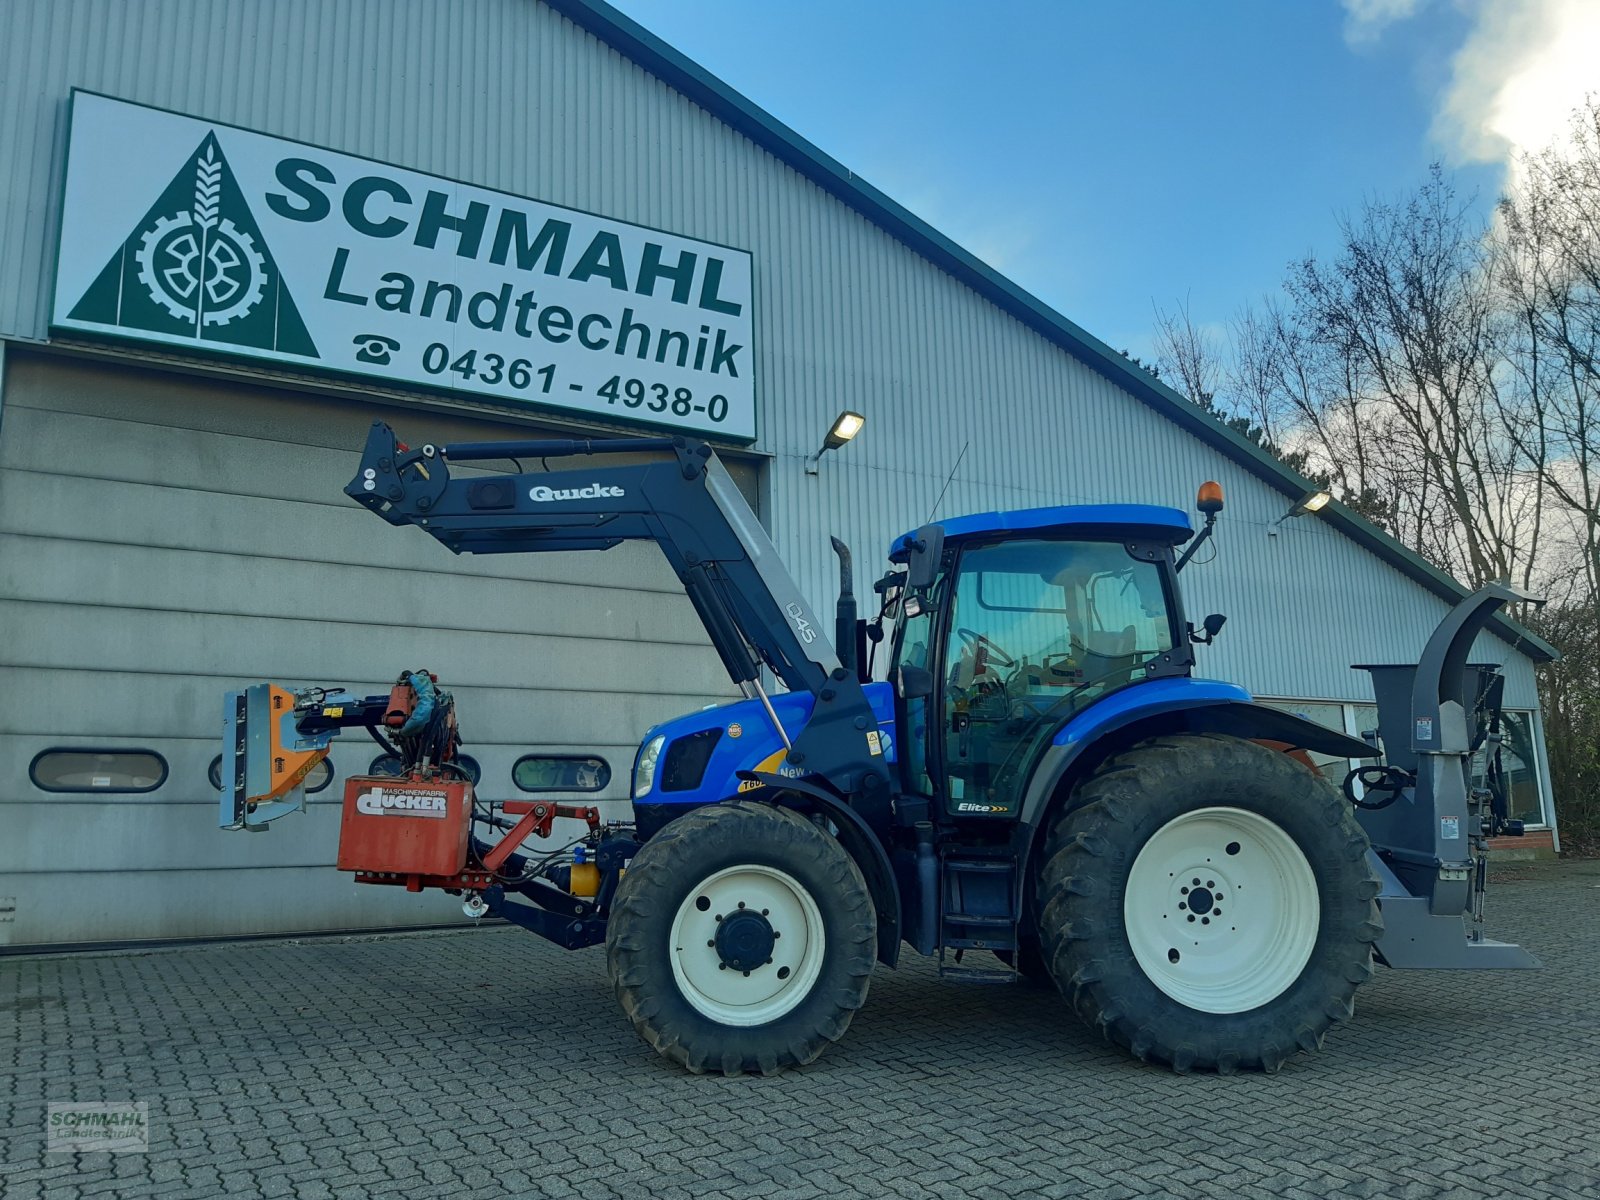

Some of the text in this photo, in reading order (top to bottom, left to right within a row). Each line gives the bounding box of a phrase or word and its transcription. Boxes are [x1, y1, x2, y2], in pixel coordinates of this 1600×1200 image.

[265, 158, 742, 317] SCHMAHL
[323, 247, 743, 378] Landtechnik
[422, 342, 556, 395] 04361
[597, 375, 729, 422] 4938-0
[529, 483, 624, 502] Quicke
[785, 602, 817, 644] Q45
[383, 788, 447, 797] MASCHINENFABRIK
[958, 803, 990, 811] Elite
